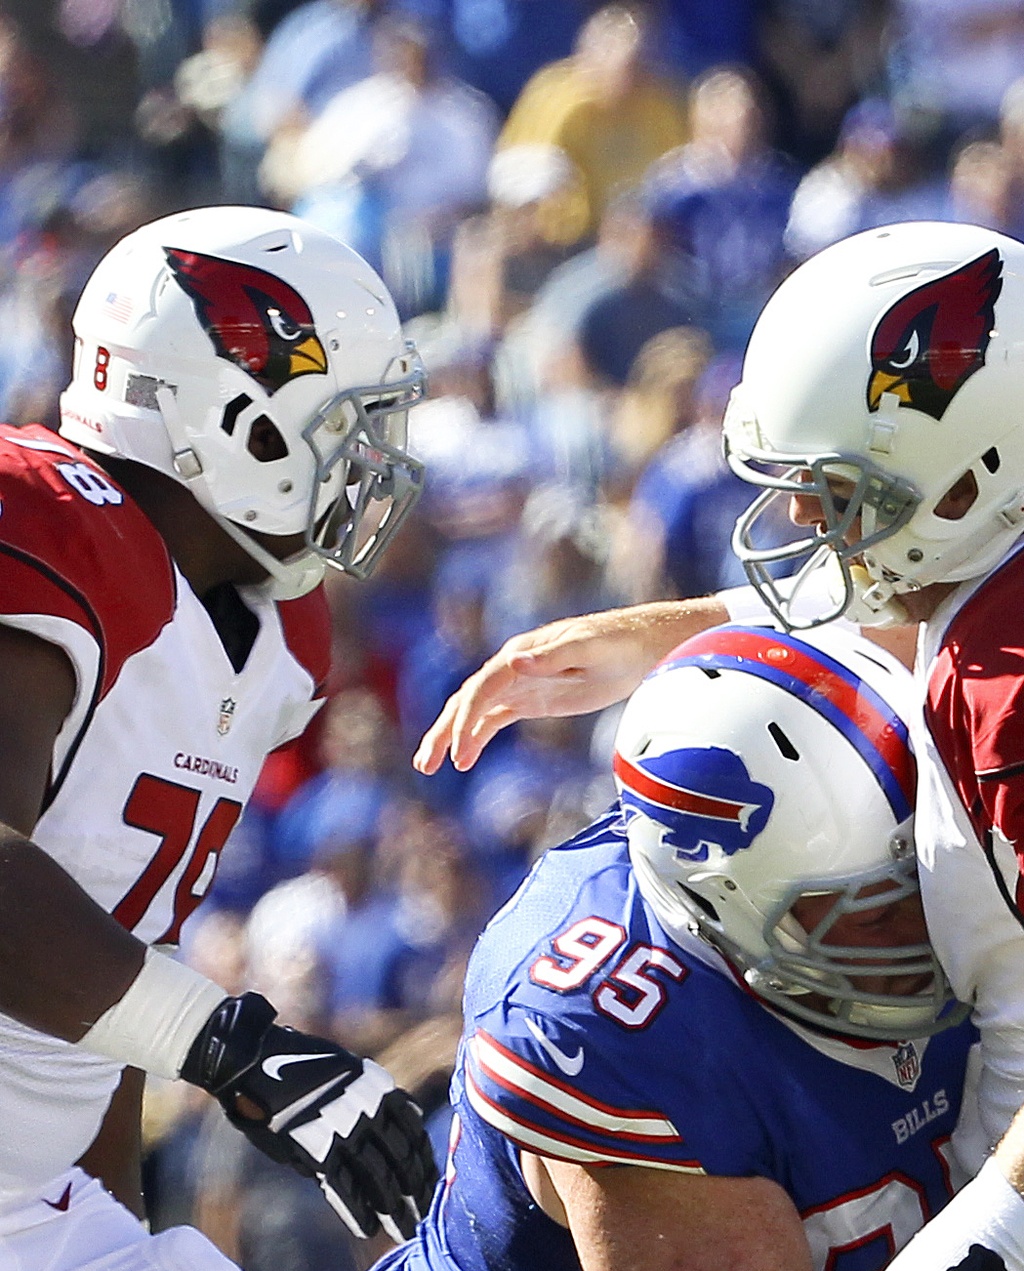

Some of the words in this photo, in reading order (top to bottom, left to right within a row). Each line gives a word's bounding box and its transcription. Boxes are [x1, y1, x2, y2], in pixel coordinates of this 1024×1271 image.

[174, 752, 239, 784] CARDINALS
[528, 914, 690, 1030] 95
[890, 1088, 950, 1146] BILLS
